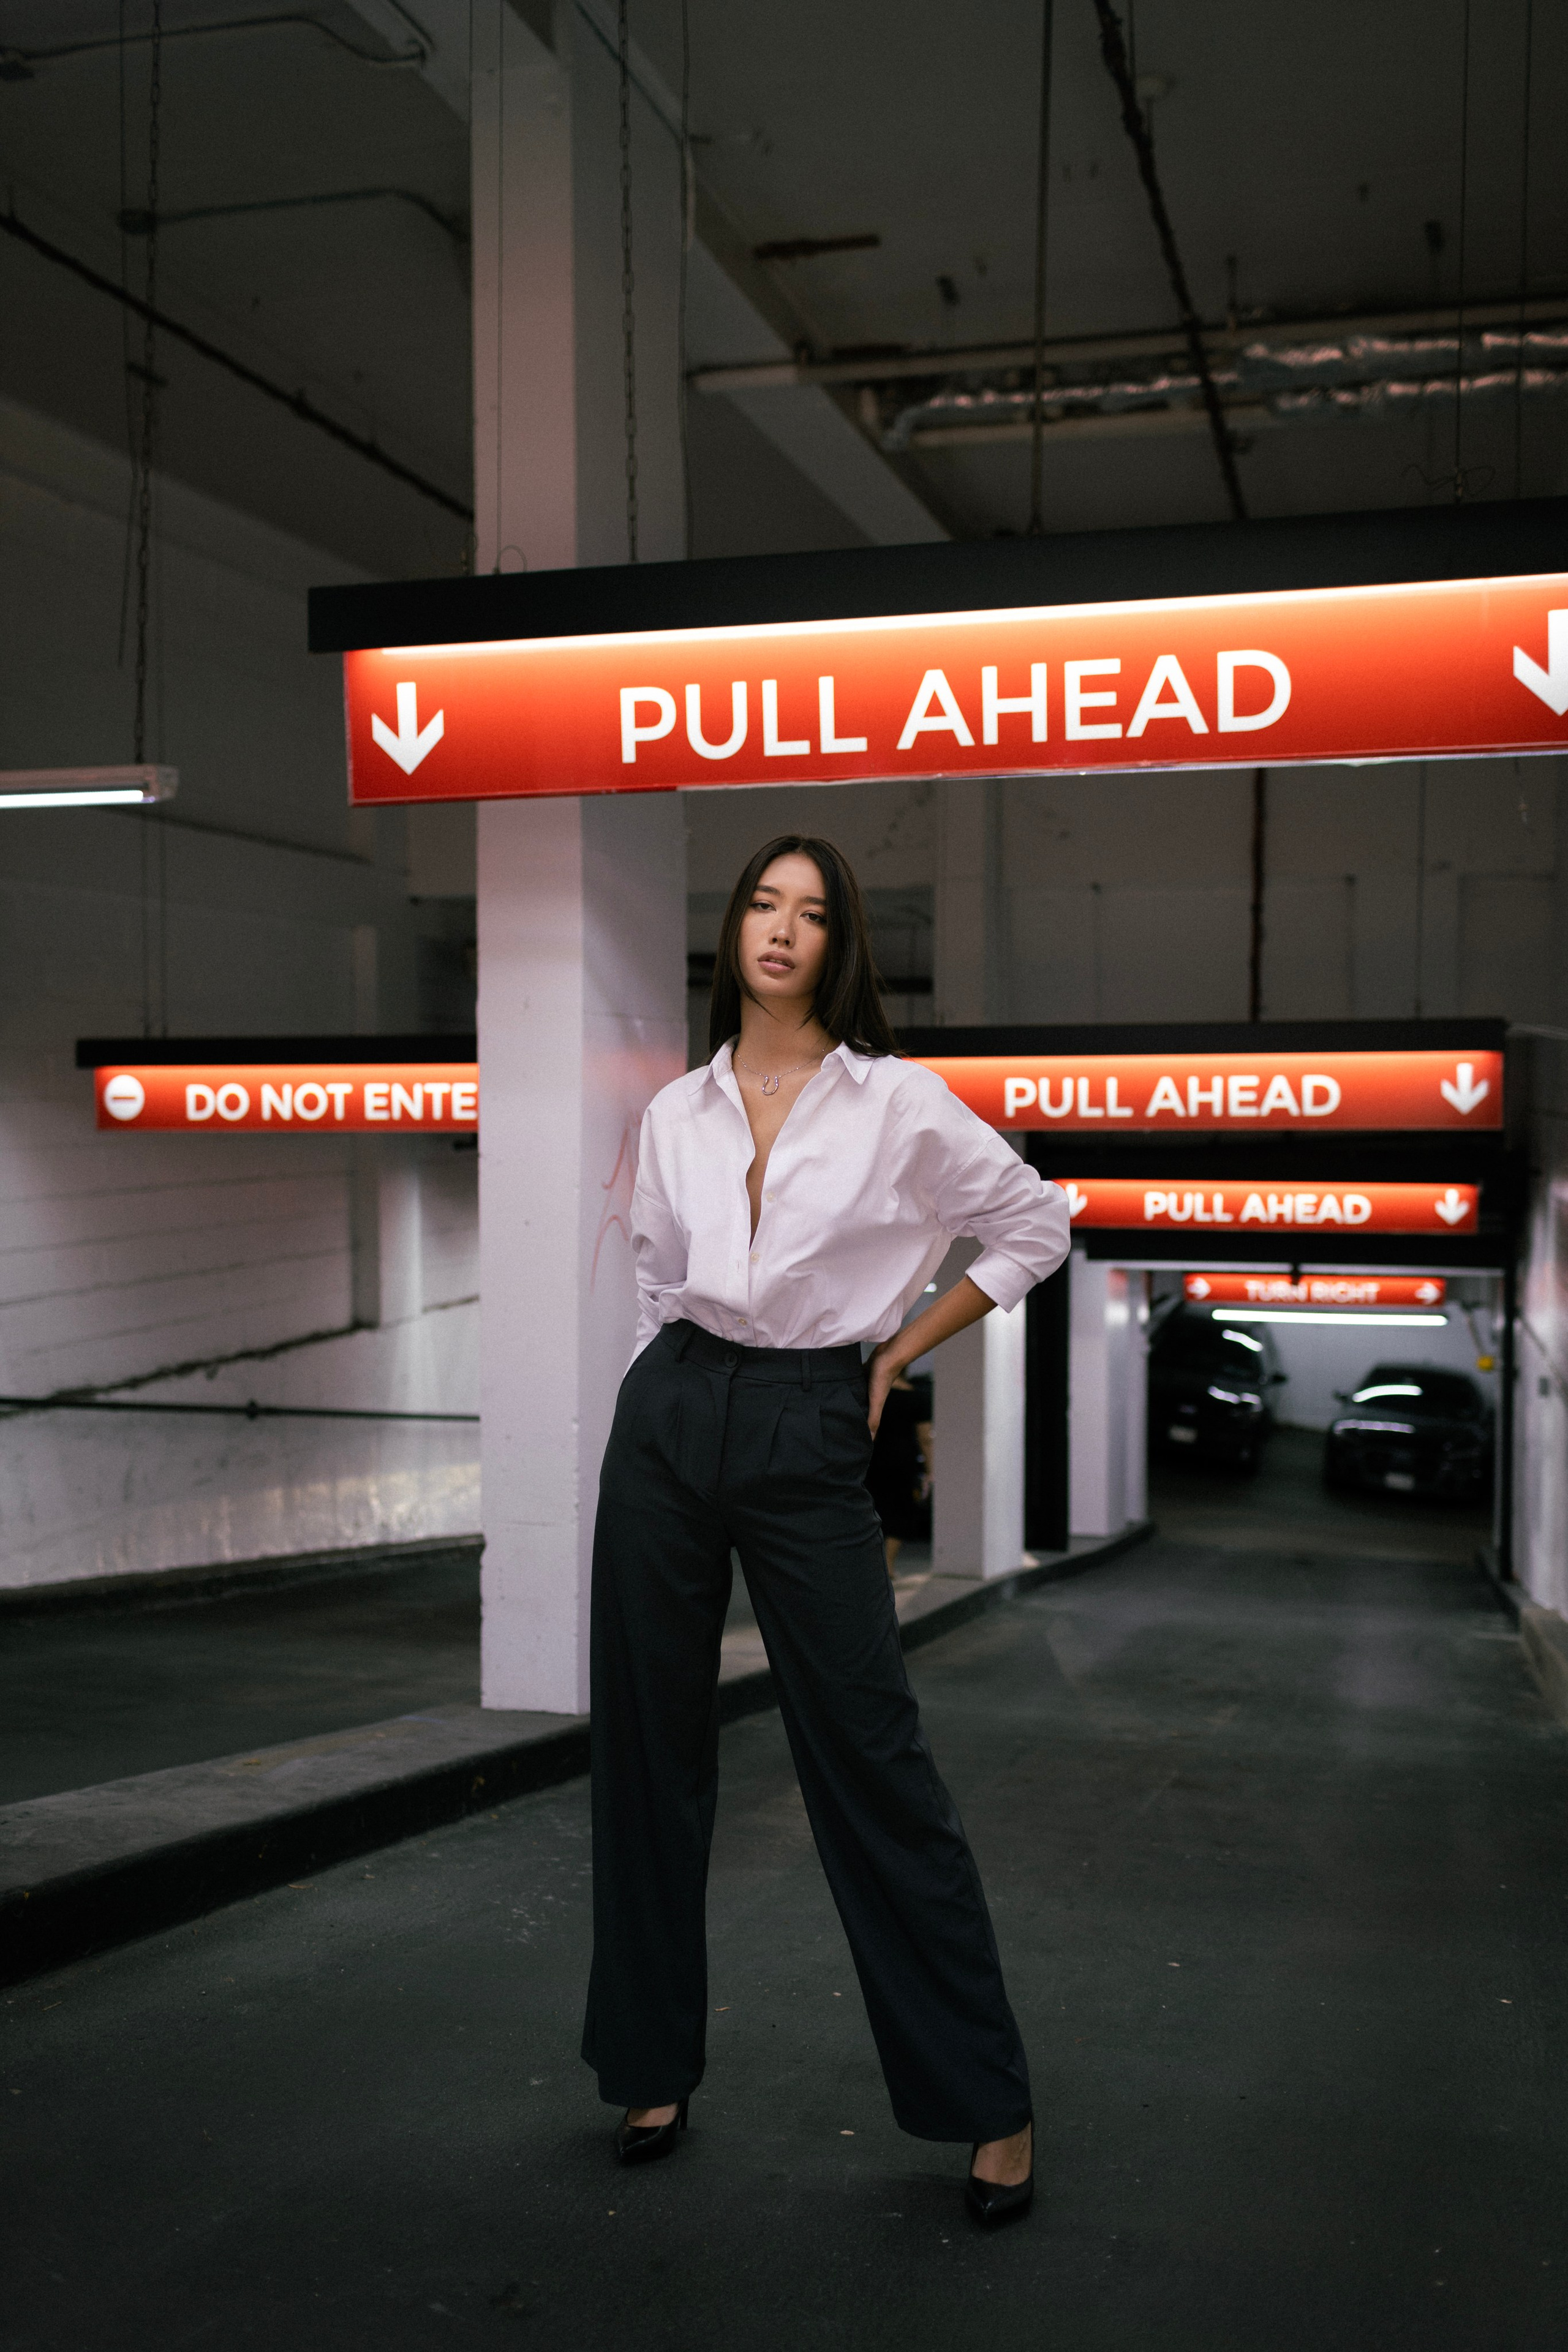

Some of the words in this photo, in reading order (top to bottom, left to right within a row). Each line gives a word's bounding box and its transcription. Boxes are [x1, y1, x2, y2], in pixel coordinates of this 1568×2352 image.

[620, 676, 868, 763] PULL
[897, 649, 1292, 750] AHEAD
[185, 1082, 251, 1120] DO
[261, 1082, 353, 1120] NOT
[364, 1082, 478, 1120] ENTE
[1005, 1076, 1133, 1117] PULL
[1146, 1074, 1341, 1116] AHEAD
[1144, 1191, 1232, 1222] PULL
[1240, 1193, 1372, 1224] AHEAD
[1245, 1280, 1308, 1302] TURN
[1310, 1281, 1380, 1303] RIGHT
